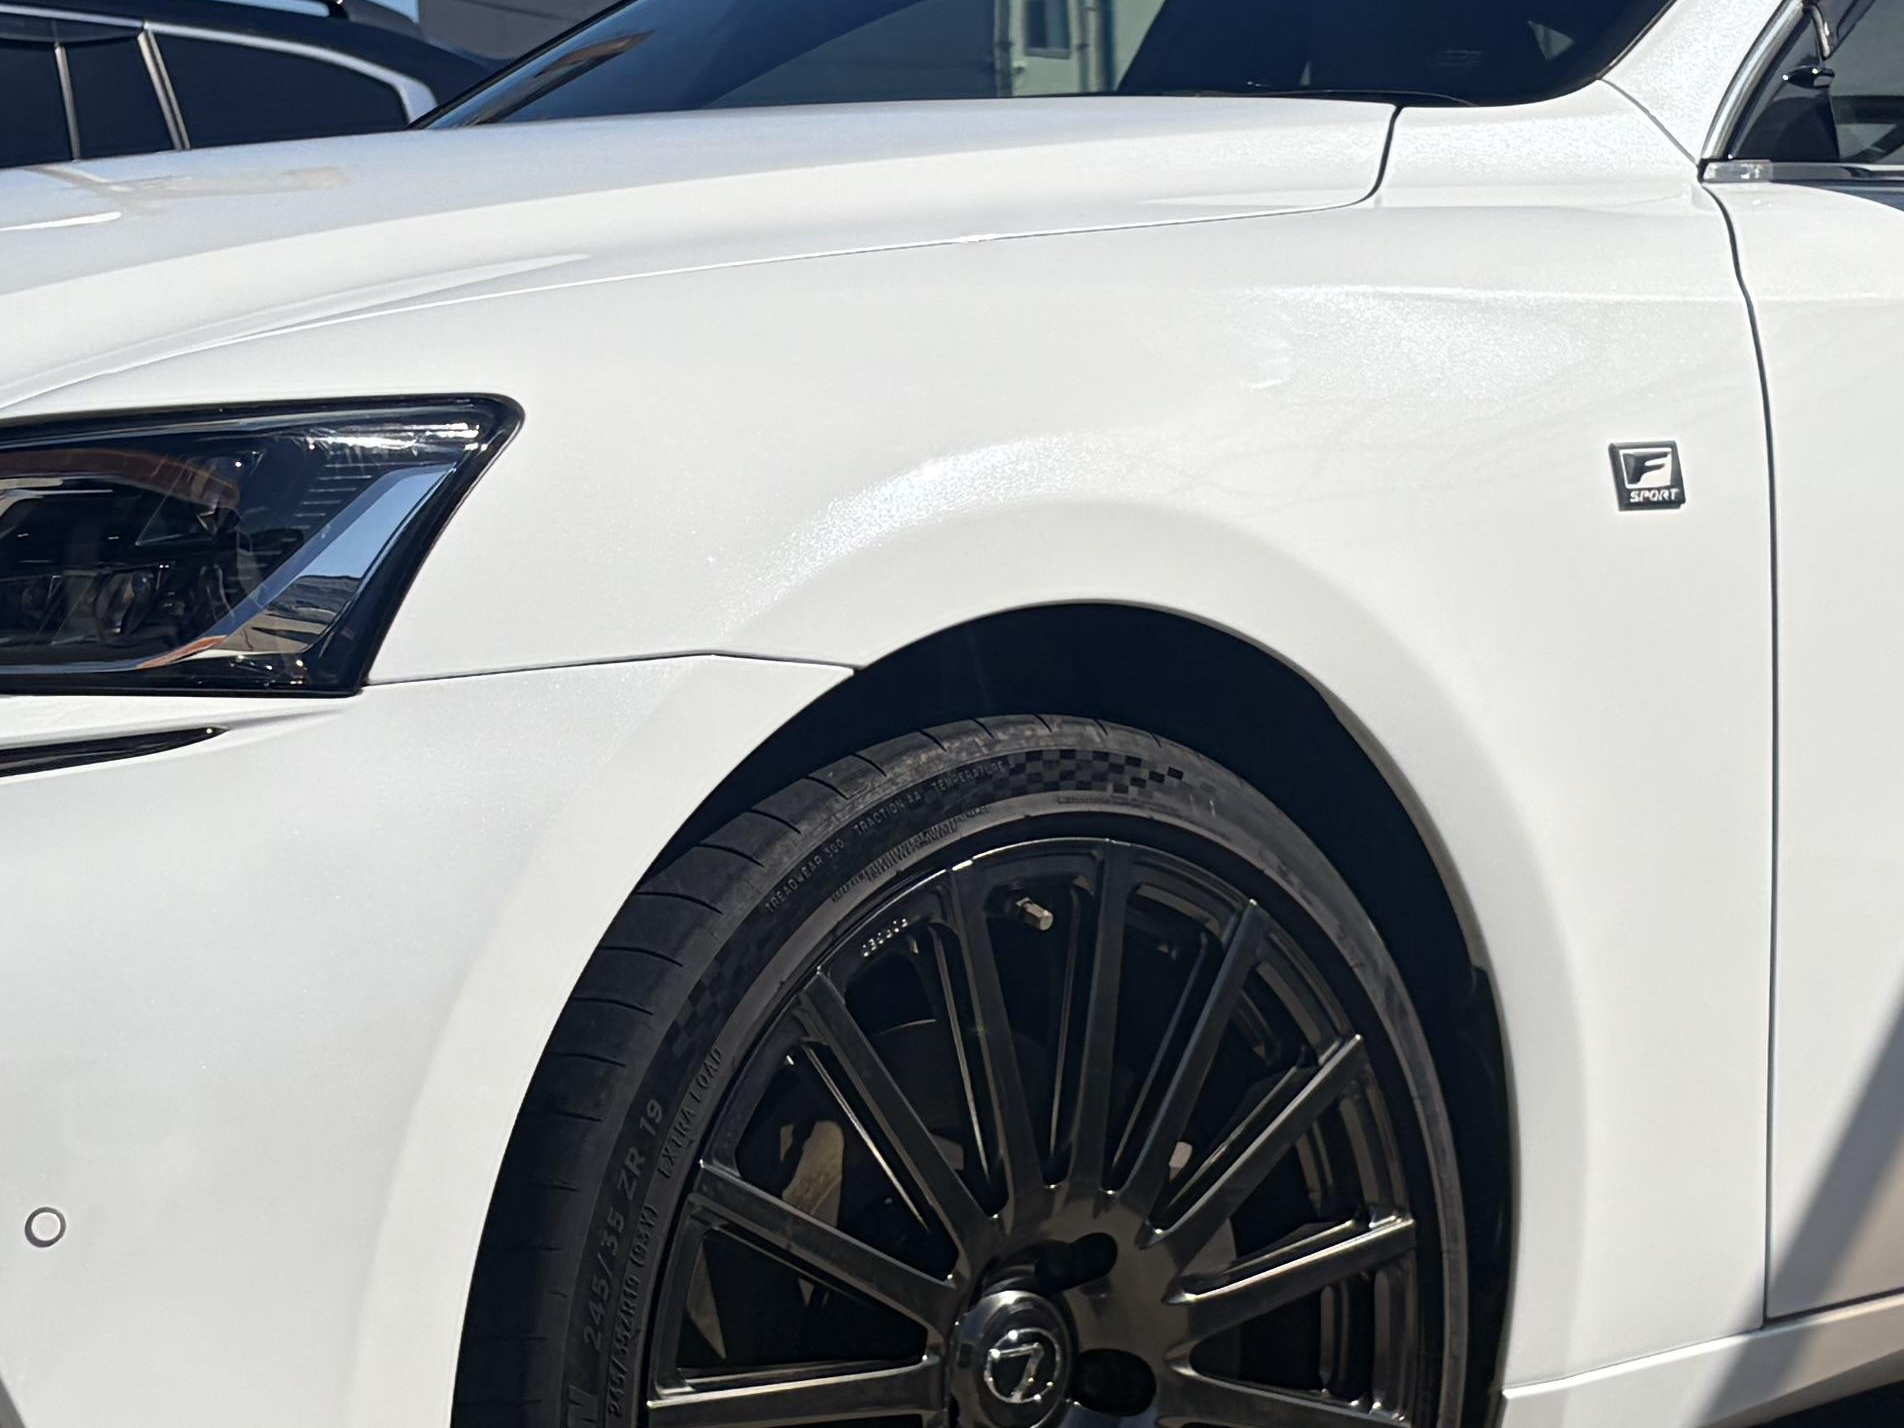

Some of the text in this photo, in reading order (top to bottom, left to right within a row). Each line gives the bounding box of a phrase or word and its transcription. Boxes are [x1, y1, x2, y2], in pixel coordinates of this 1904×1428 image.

[1623, 451, 1671, 485] F
[1629, 488, 1679, 503] SPORT
[764, 854, 824, 914] TREADWEAR
[852, 800, 905, 837] TRACTION
[656, 1107, 696, 1179] EXTRA
[688, 1047, 722, 1104] LOAD
[583, 1206, 625, 1353] 245/35
[616, 1146, 646, 1203] ZR
[639, 1098, 663, 1136] 19
